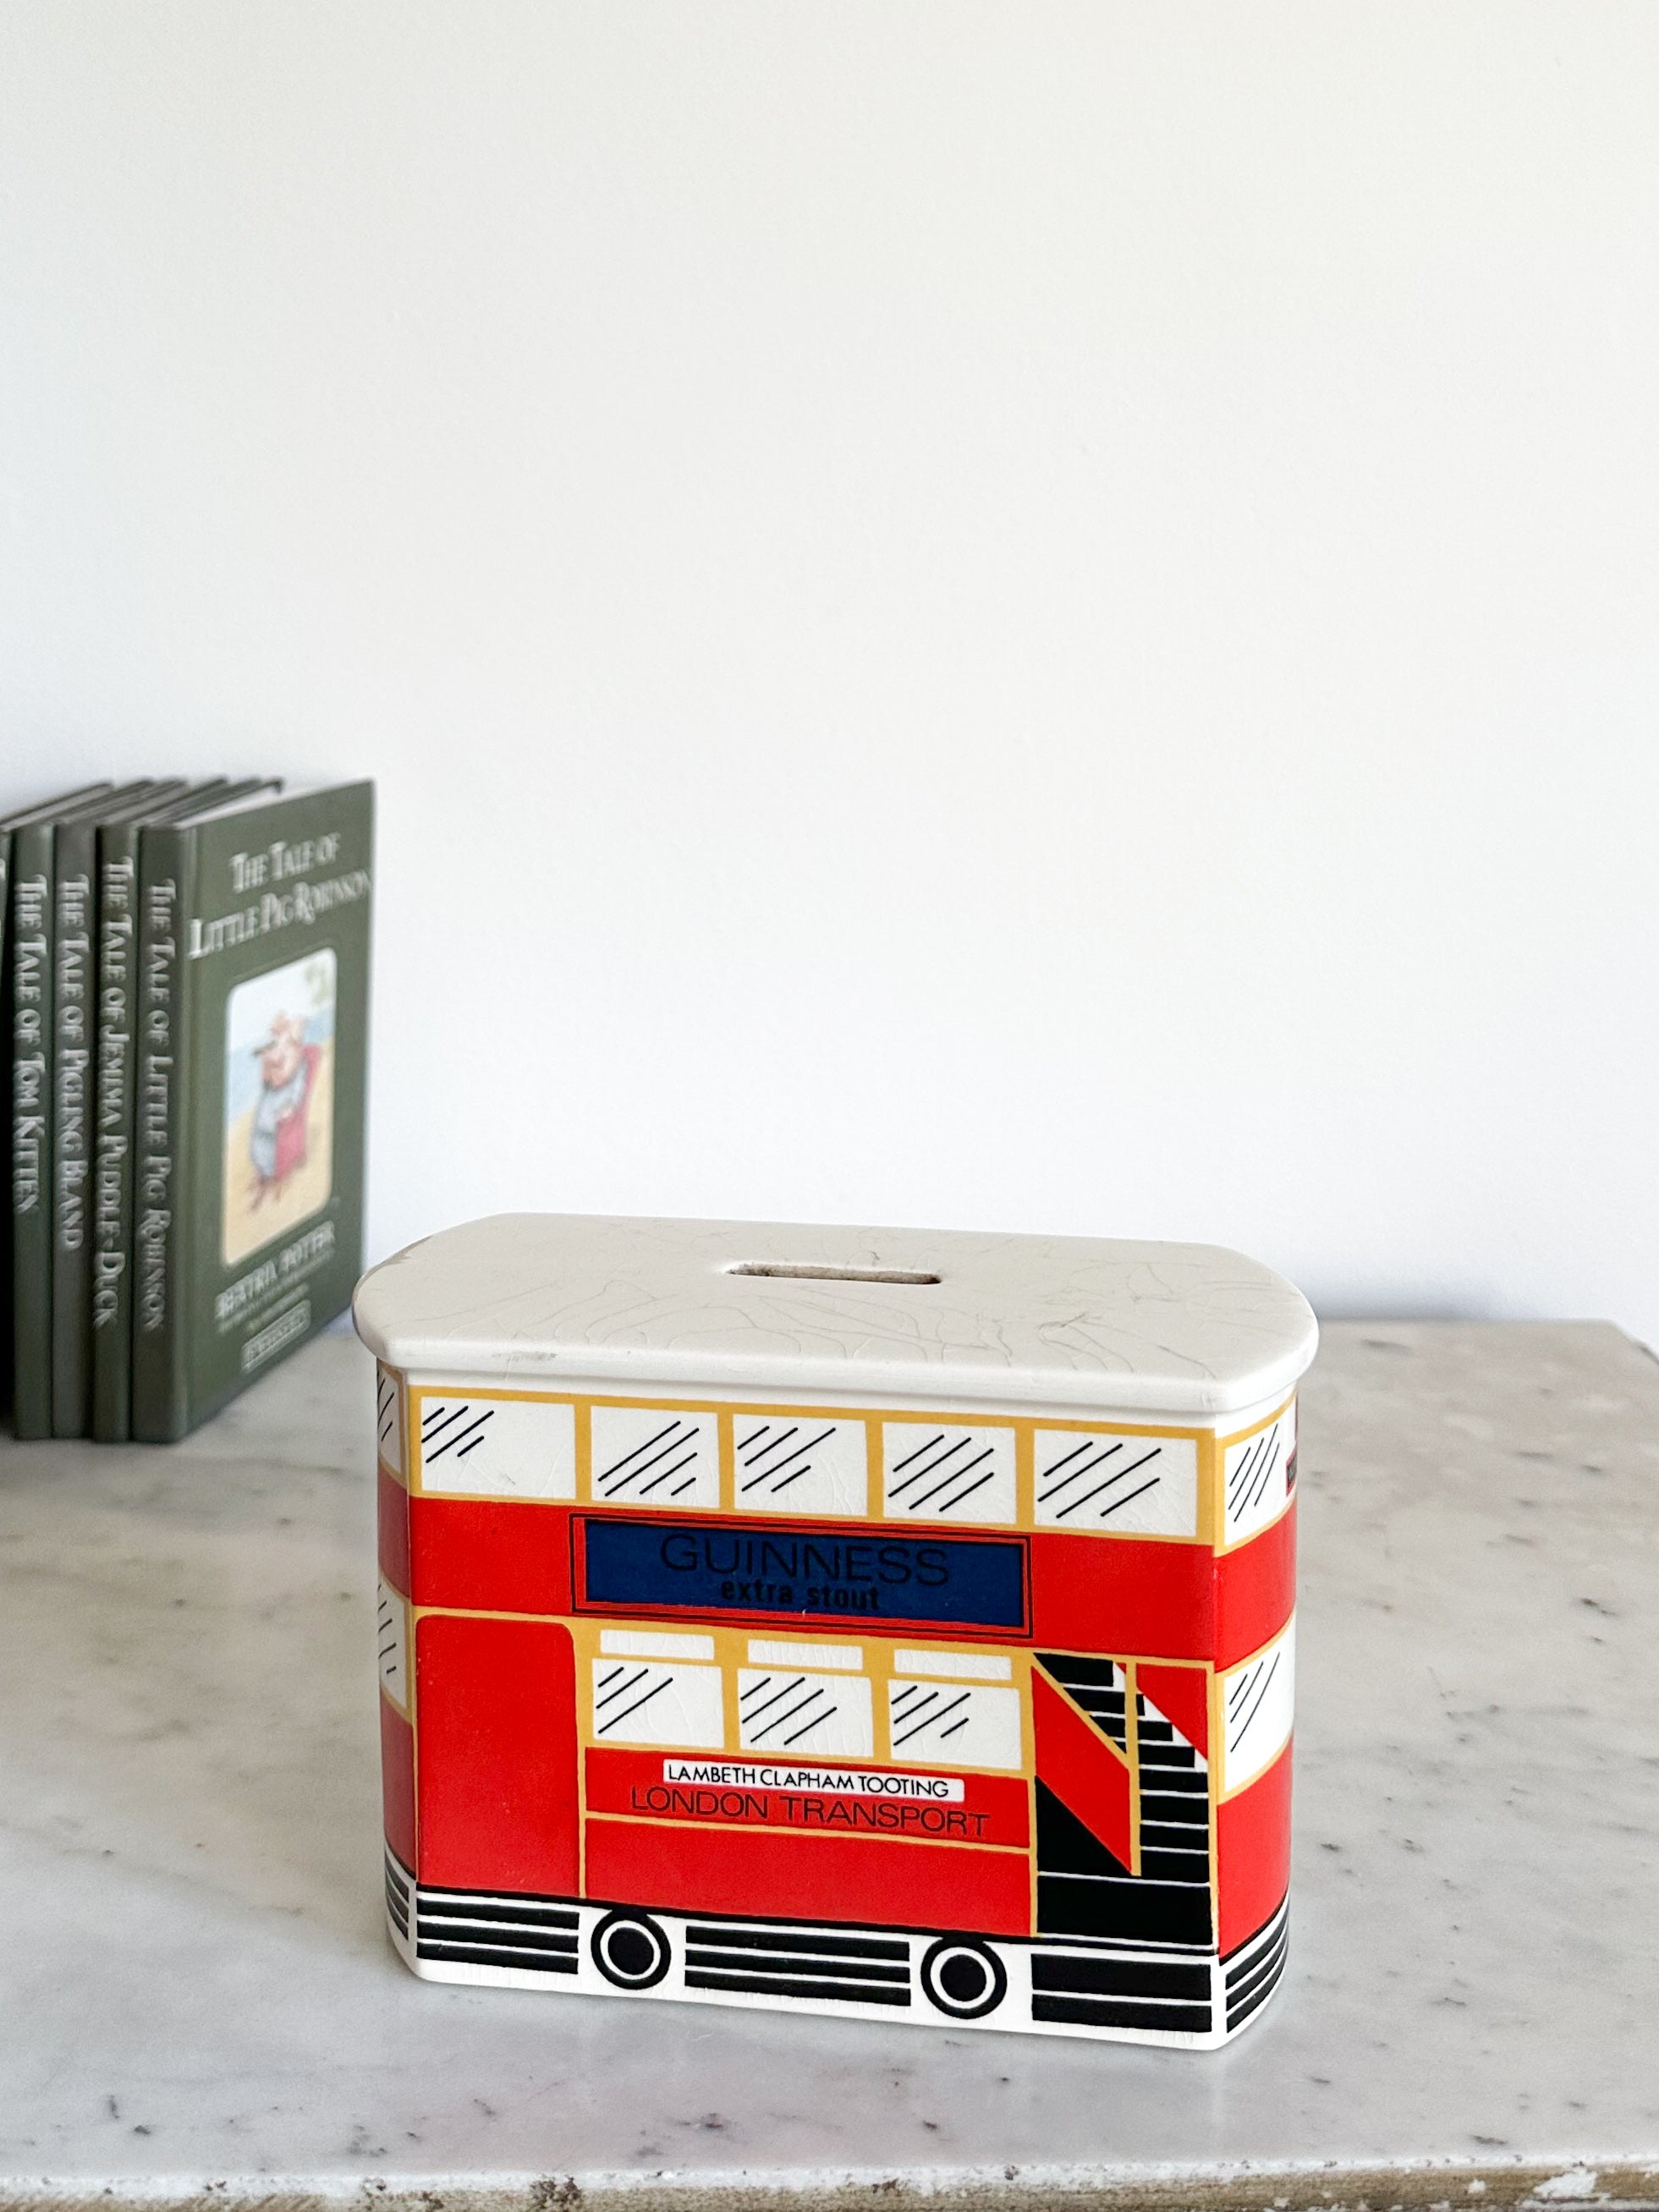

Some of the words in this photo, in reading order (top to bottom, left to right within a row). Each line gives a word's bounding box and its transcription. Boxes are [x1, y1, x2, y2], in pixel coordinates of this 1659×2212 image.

[102, 856, 134, 909] THE
[229, 851, 270, 894] THE
[268, 839, 316, 881] TALE
[316, 832, 342, 866] OF
[16, 874, 47, 929] THE
[58, 874, 90, 928] THE
[148, 878, 176, 930] THE
[186, 917, 261, 961] LITTLE
[259, 892, 294, 935] PIG
[15, 933, 47, 1002] TALE
[58, 931, 90, 999] TALE
[102, 914, 133, 982] TALE
[148, 936, 176, 1002] TALE
[14, 1008, 41, 1046] OF
[58, 1005, 85, 1041] OF
[101, 987, 127, 1024] OF
[146, 1010, 170, 1046] OF
[14, 1051, 45, 1108] TOM
[58, 1049, 89, 1152] PIGLING
[99, 1024, 129, 1128] JEMIMA
[145, 1056, 173, 1146] LITTLE
[13, 1116, 45, 1213] KITTEN
[143, 1155, 172, 1201] PIG
[58, 1160, 88, 1251] BLAND
[139, 1209, 172, 1331] ROBINSON
[659, 1532, 950, 1588] GUINNESS
[721, 1578, 794, 1605] extra
[806, 1584, 880, 1611] stout
[667, 1764, 755, 1785] LAMBETH
[760, 1768, 854, 1791] CLAPHAM
[858, 1776, 949, 1798] TOOTING
[631, 1786, 768, 1820] LONDON
[779, 1795, 990, 1837] TRANSPORT
